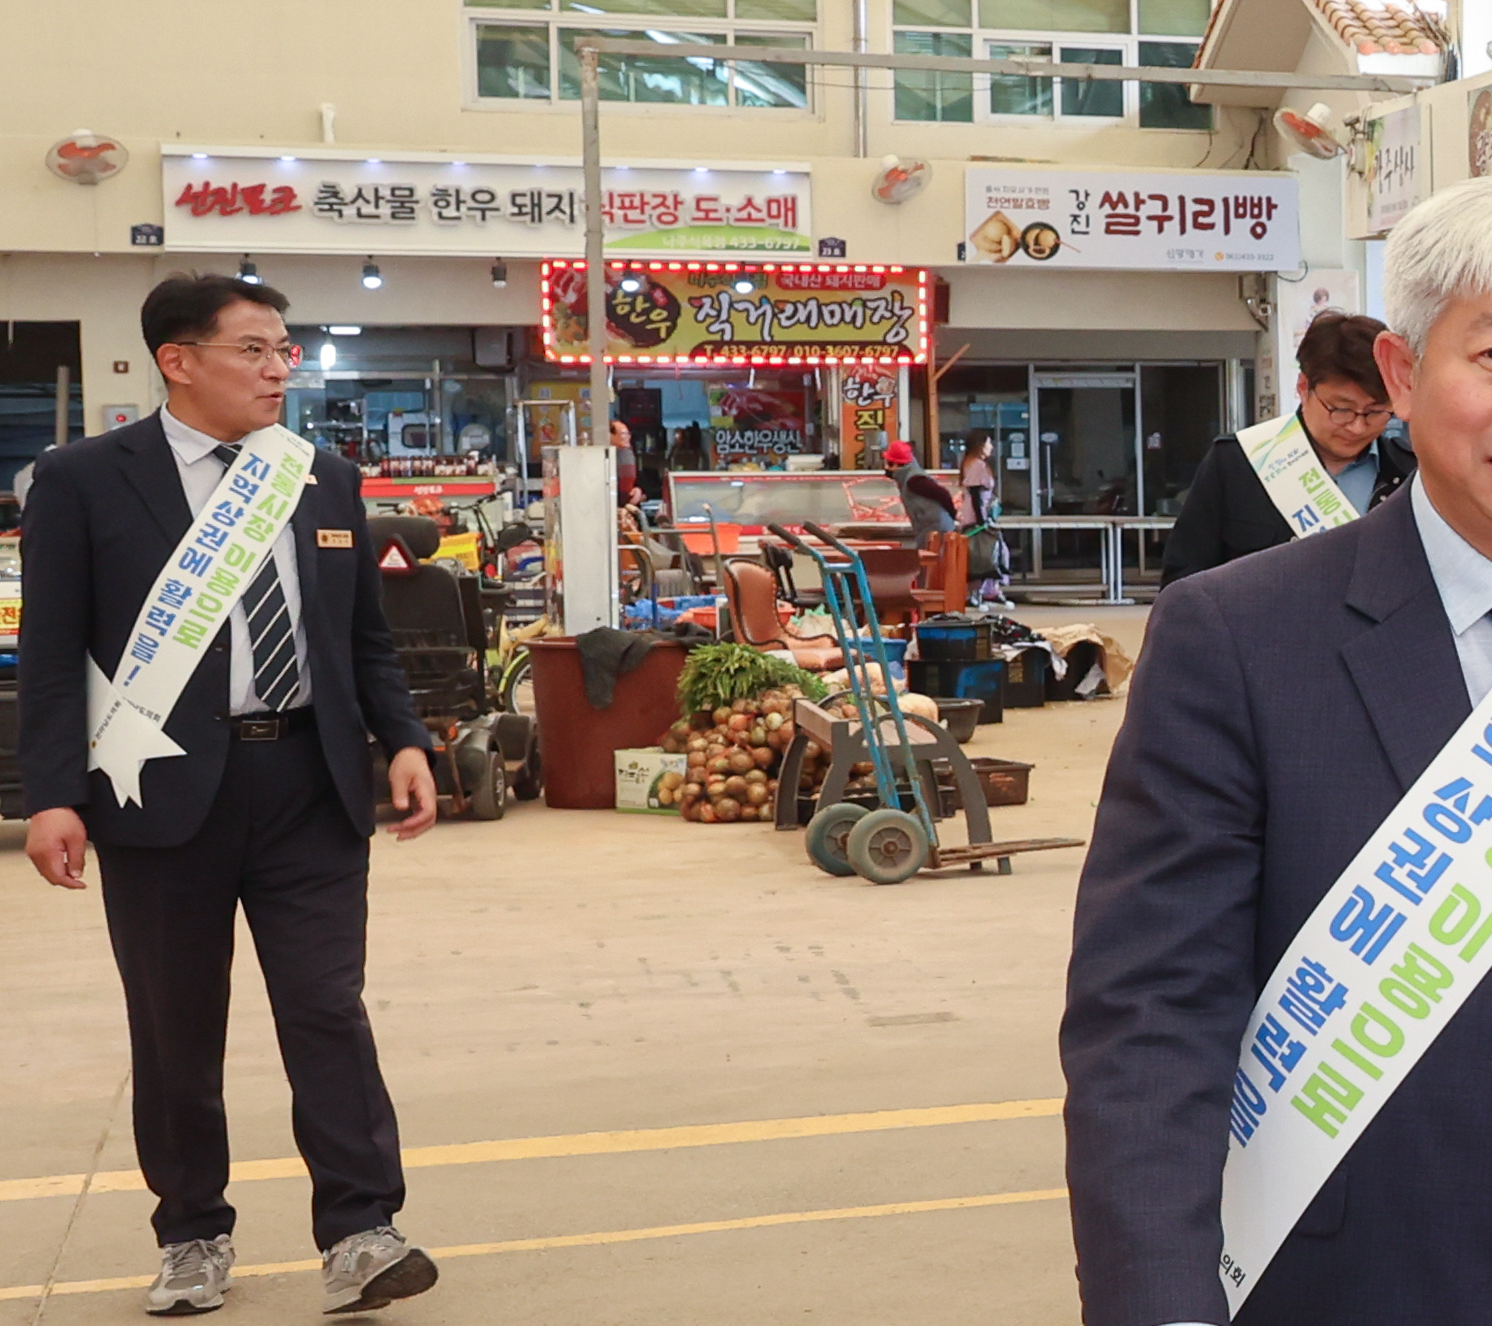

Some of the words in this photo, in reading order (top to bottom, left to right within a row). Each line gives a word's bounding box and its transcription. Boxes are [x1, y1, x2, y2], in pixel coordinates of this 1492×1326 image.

[314, 183, 421, 221] 축산물
[430, 184, 500, 222] 한우
[510, 190, 576, 224] 돼지
[1068, 190, 1091, 235] 강진
[1099, 190, 1279, 240] 쌀귀리빵
[730, 235, 800, 251] 433-6797
[780, 274, 822, 289] 국내산
[611, 290, 672, 341] 한우
[690, 290, 914, 344] 직거래매장
[721, 343, 787, 358] 433-6797
[794, 344, 899, 359] 010-3607-6797
[178, 453, 271, 577] 지역상권에
[243, 452, 304, 543] 전통시장
[172, 543, 256, 650] 이용으로
[1228, 956, 1350, 1148] 활력을
